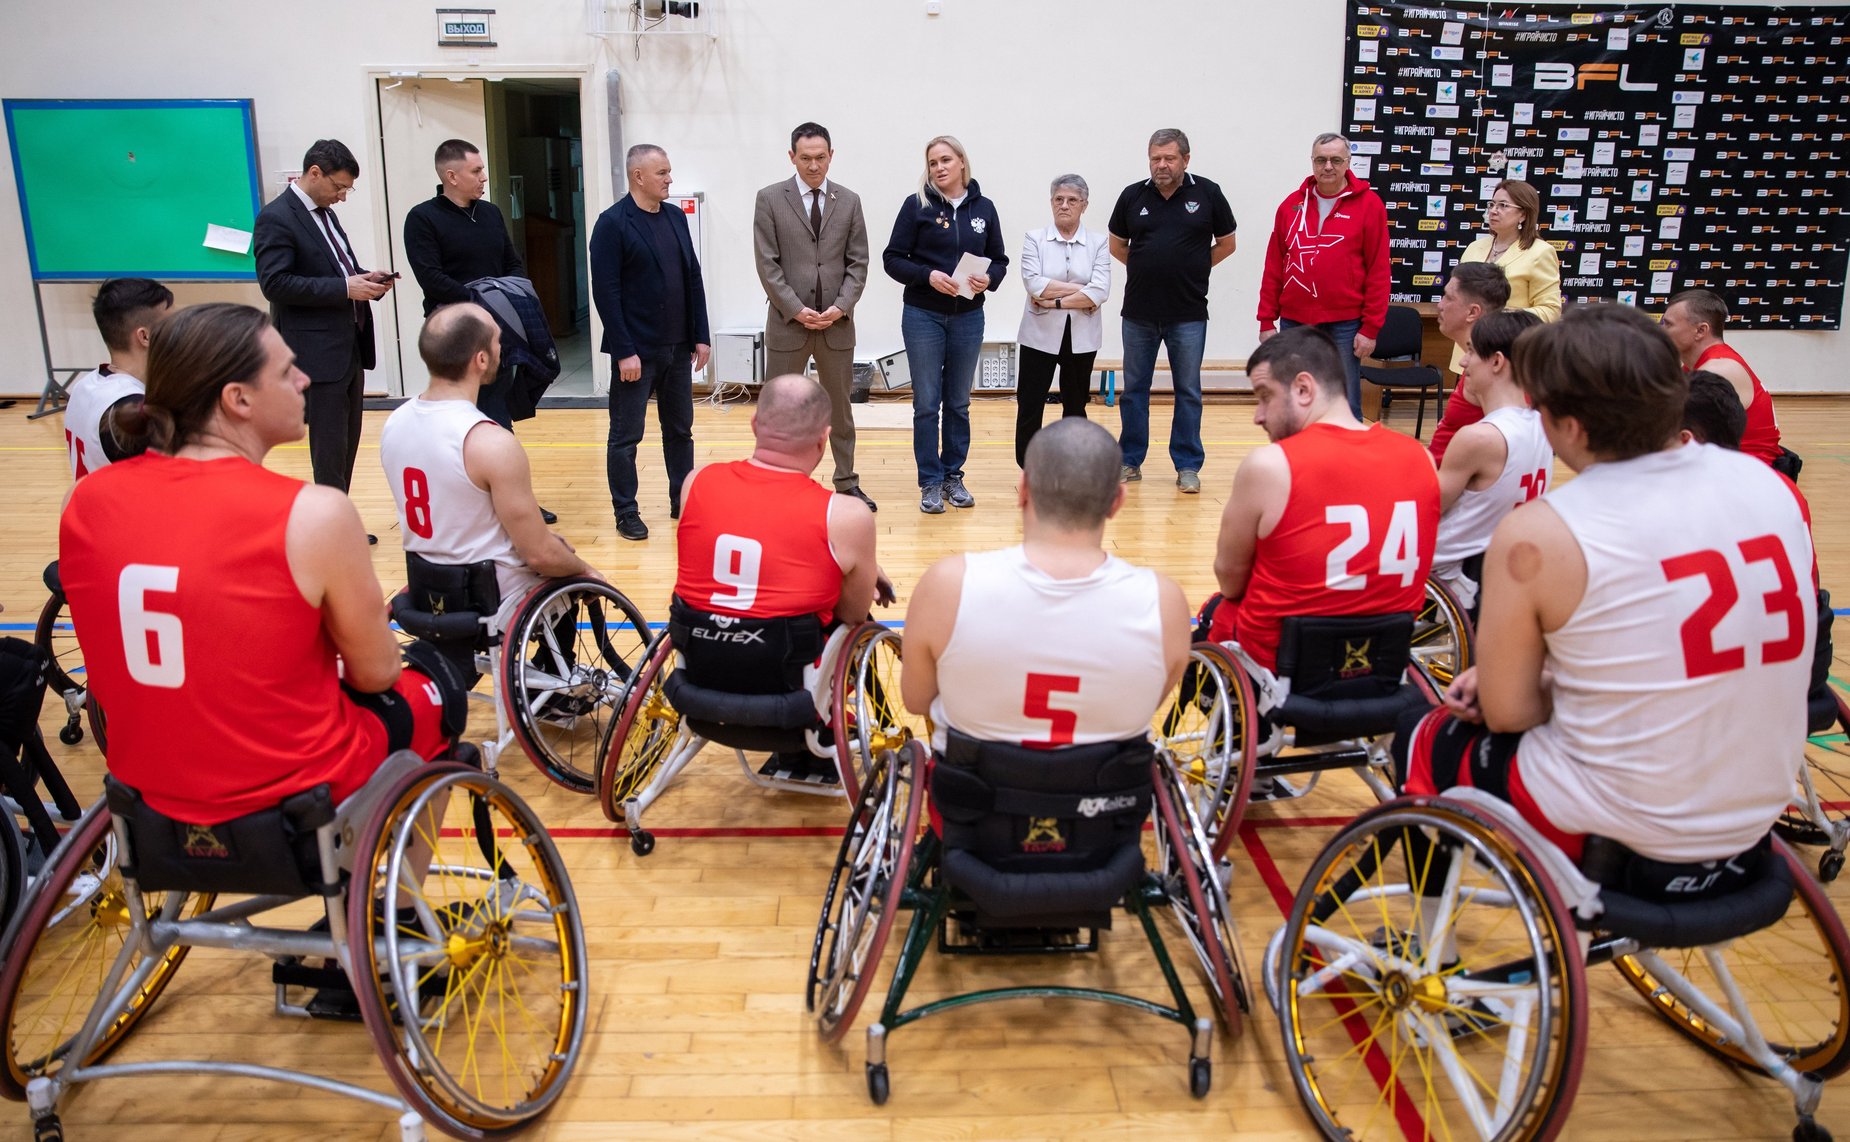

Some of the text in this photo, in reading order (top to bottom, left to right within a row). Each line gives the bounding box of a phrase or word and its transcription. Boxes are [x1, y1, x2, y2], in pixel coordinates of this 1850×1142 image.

[1358, 7, 1391, 16] BFL
[1403, 8, 1446, 19] #ИГРАЙЧИСТО
[1457, 12, 1489, 20] BFL
[1526, 14, 1559, 23] BFL
[1614, 15, 1645, 23] BFL
[1683, 16, 1715, 24] BFL
[1722, 17, 1755, 25] BFL
[447, 24, 484, 33] ВЫХОД
[1398, 29, 1431, 37] BFL
[1470, 31, 1503, 40] BFL
[1515, 31, 1557, 42] #ИГРАЙЧИСТО
[1567, 34, 1599, 42] BFL
[1636, 34, 1668, 42] BFL
[1735, 36, 1767, 44] BFL
[1782, 37, 1814, 45] BFL
[1386, 48, 1420, 56] BFL
[1476, 51, 1509, 59] BFL
[1717, 56, 1749, 64] BFL
[1354, 66, 1386, 75] BFL
[1398, 66, 1441, 78] #ИГРАЙЧИСТО
[1451, 70, 1483, 78] BFL
[1534, 63, 1658, 91] BFL
[1675, 74, 1707, 82] BFL
[1775, 76, 1806, 84] BFL
[1393, 87, 1427, 96] BFL
[1465, 89, 1497, 98] BFL
[1755, 95, 1786, 103] BFL
[1383, 106, 1414, 115] BFL
[1472, 108, 1504, 117] BFL
[1584, 110, 1625, 121] #ИГРАЙЧИСТО
[1635, 112, 1667, 120] BFL
[1350, 125, 1384, 133] BFL
[1394, 125, 1435, 136] #ИГРАЙЧИСТО
[1445, 127, 1478, 136] BFL
[1515, 129, 1547, 137] BFL
[1749, 133, 1781, 141] BFL
[1391, 145, 1421, 153] BFL
[1458, 147, 1492, 155] BFL
[1554, 149, 1585, 157] BFL
[1621, 150, 1652, 158] BFL
[1378, 164, 1411, 172] BFL
[1465, 166, 1498, 174] BFL
[1582, 166, 1618, 177] ИГРАЙЧИСТО
[1700, 170, 1731, 178] BFL
[1390, 181, 1430, 193] #ИГРАЙЧИСТО
[1440, 184, 1472, 192] BFL
[1386, 201, 1419, 210] BFL
[1453, 203, 1486, 211] BFL
[1389, 238, 1427, 248] ИГРАЙЧИСТО
[1437, 240, 1467, 248] BFL
[1390, 257, 1413, 265] FL
[1563, 277, 1603, 287] #ИГРАЙЧИСТО
[403, 467, 433, 539] 8
[1325, 500, 1420, 590] 24
[709, 533, 762, 610] 9
[1661, 534, 1805, 679] 23
[119, 563, 186, 689] 6
[691, 627, 765, 645] ELITEX
[1022, 673, 1080, 748] 5
